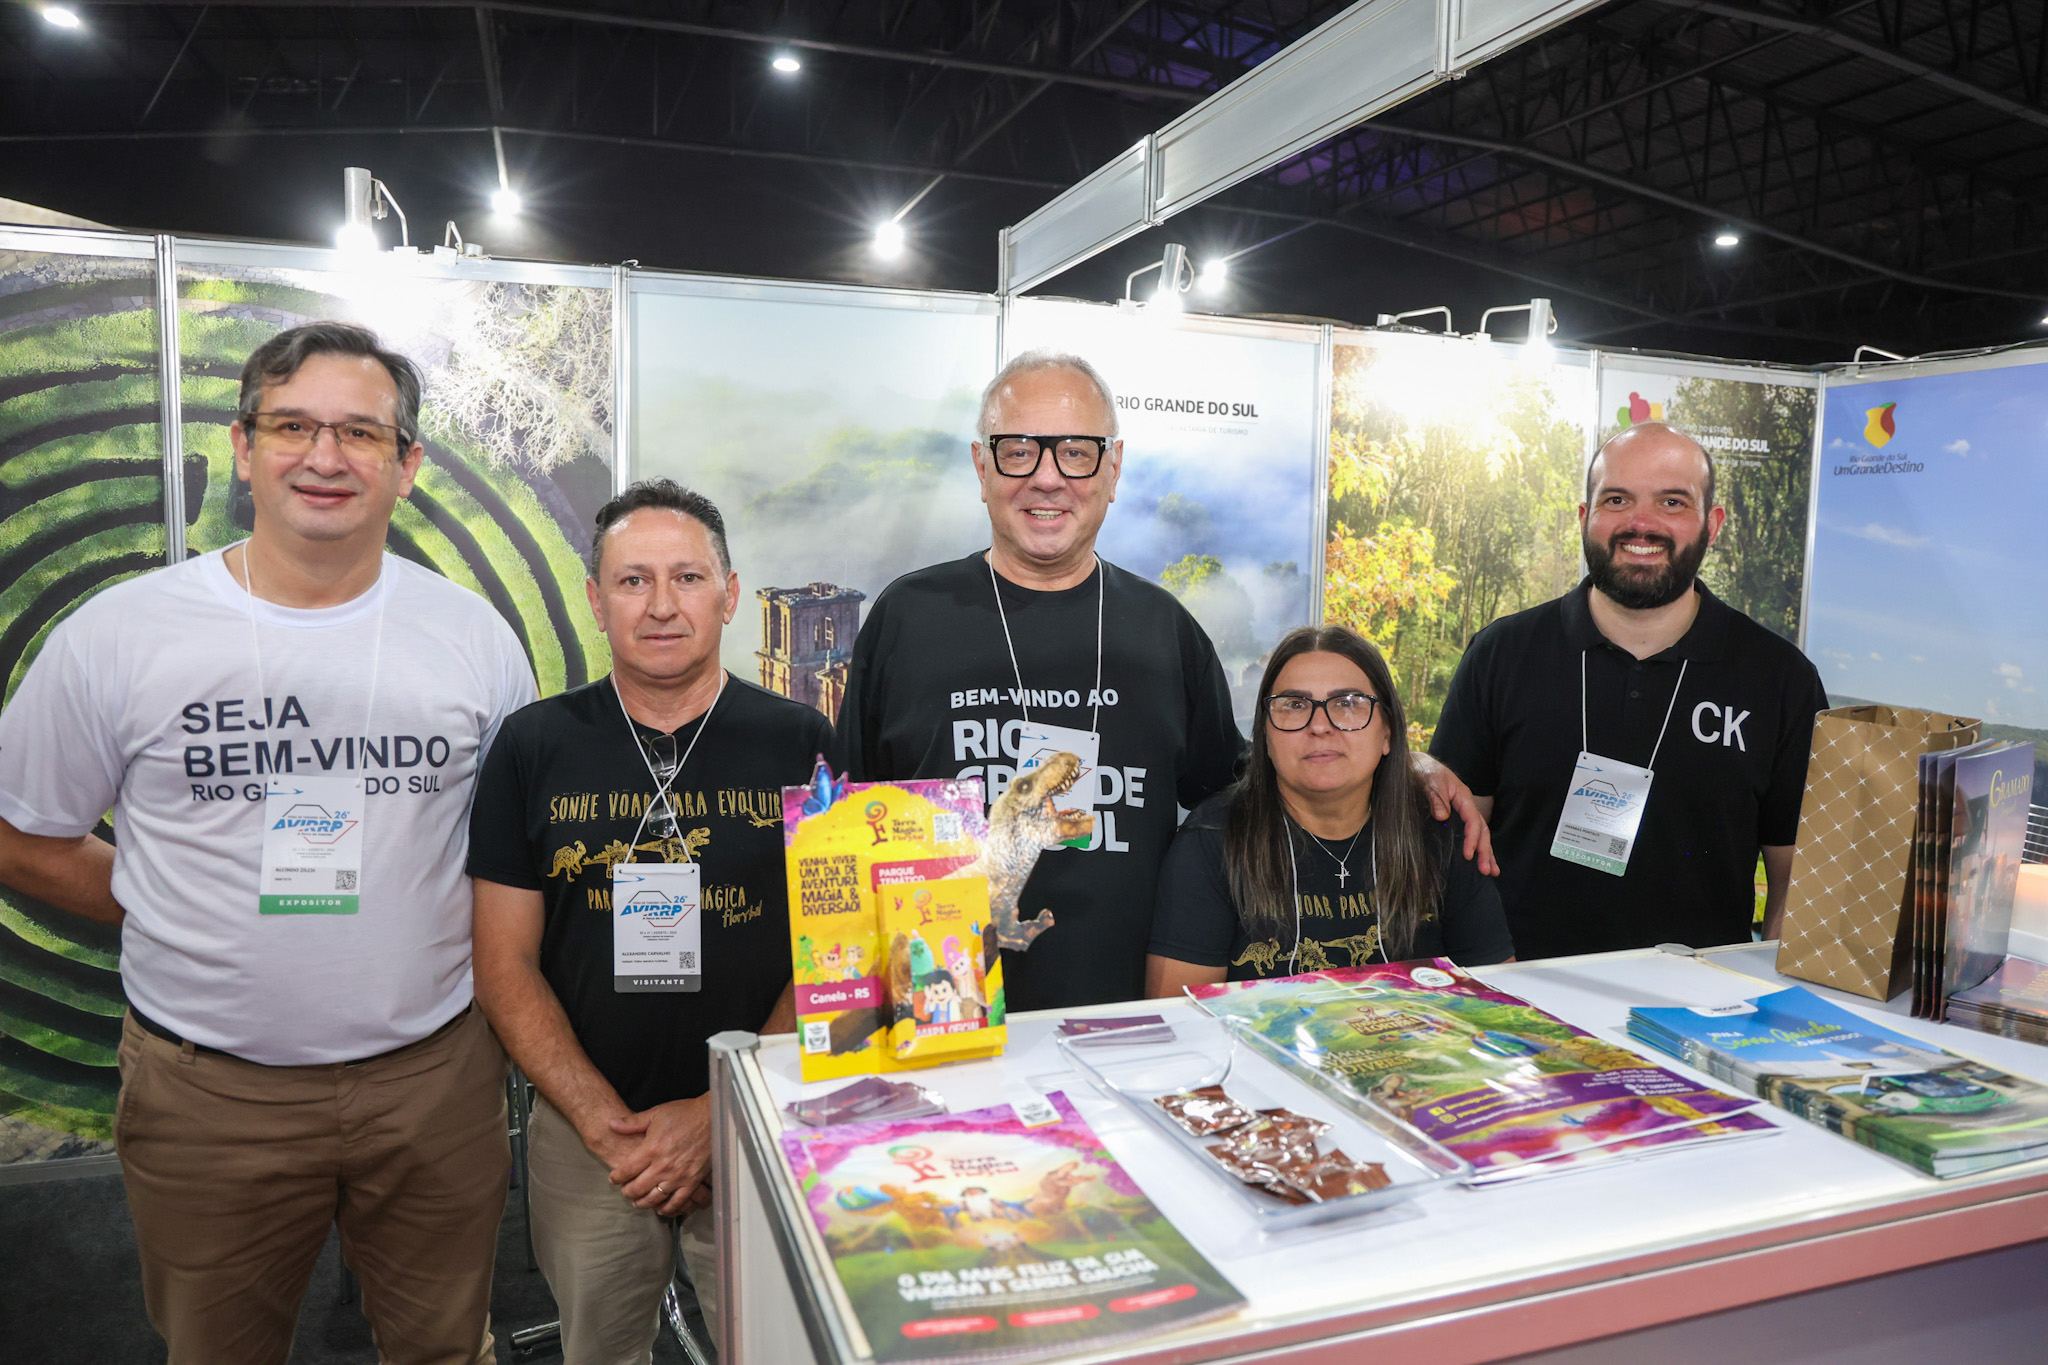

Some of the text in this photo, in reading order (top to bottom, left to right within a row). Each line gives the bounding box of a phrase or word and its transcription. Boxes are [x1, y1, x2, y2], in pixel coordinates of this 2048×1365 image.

[1116, 396, 1259, 418] RIO GRANDE DO SUL
[1733, 437, 1749, 451] DO
[1750, 439, 1770, 453] SUL
[1849, 452, 1908, 463] Rio Grande do Sul
[950, 688, 1119, 709] BEM-VINDO AO
[182, 695, 310, 735] SEJA
[1691, 701, 1751, 752] CK
[183, 736, 451, 778] BEM-VINDO
[191, 783, 235, 802] RIO
[365, 777, 400, 795] DO
[408, 775, 440, 794] SUL
[1572, 787, 1628, 808] AVIRRP
[550, 793, 599, 823] SONHE
[272, 819, 344, 832] AVIRRP
[798, 855, 857, 866] VENHA VIVER
[1564, 849, 1612, 867] EXPOSITOR
[799, 867, 820, 878] UM
[844, 864, 858, 875] DE
[878, 866, 915, 877] PARQUE
[801, 876, 859, 889] AVENTURA
[849, 887, 859, 900] &
[279, 899, 342, 907] EXPOSITOR
[620, 904, 682, 916] AVIRRP
[809, 990, 848, 1004] Canela
[854, 987, 870, 999] RS
